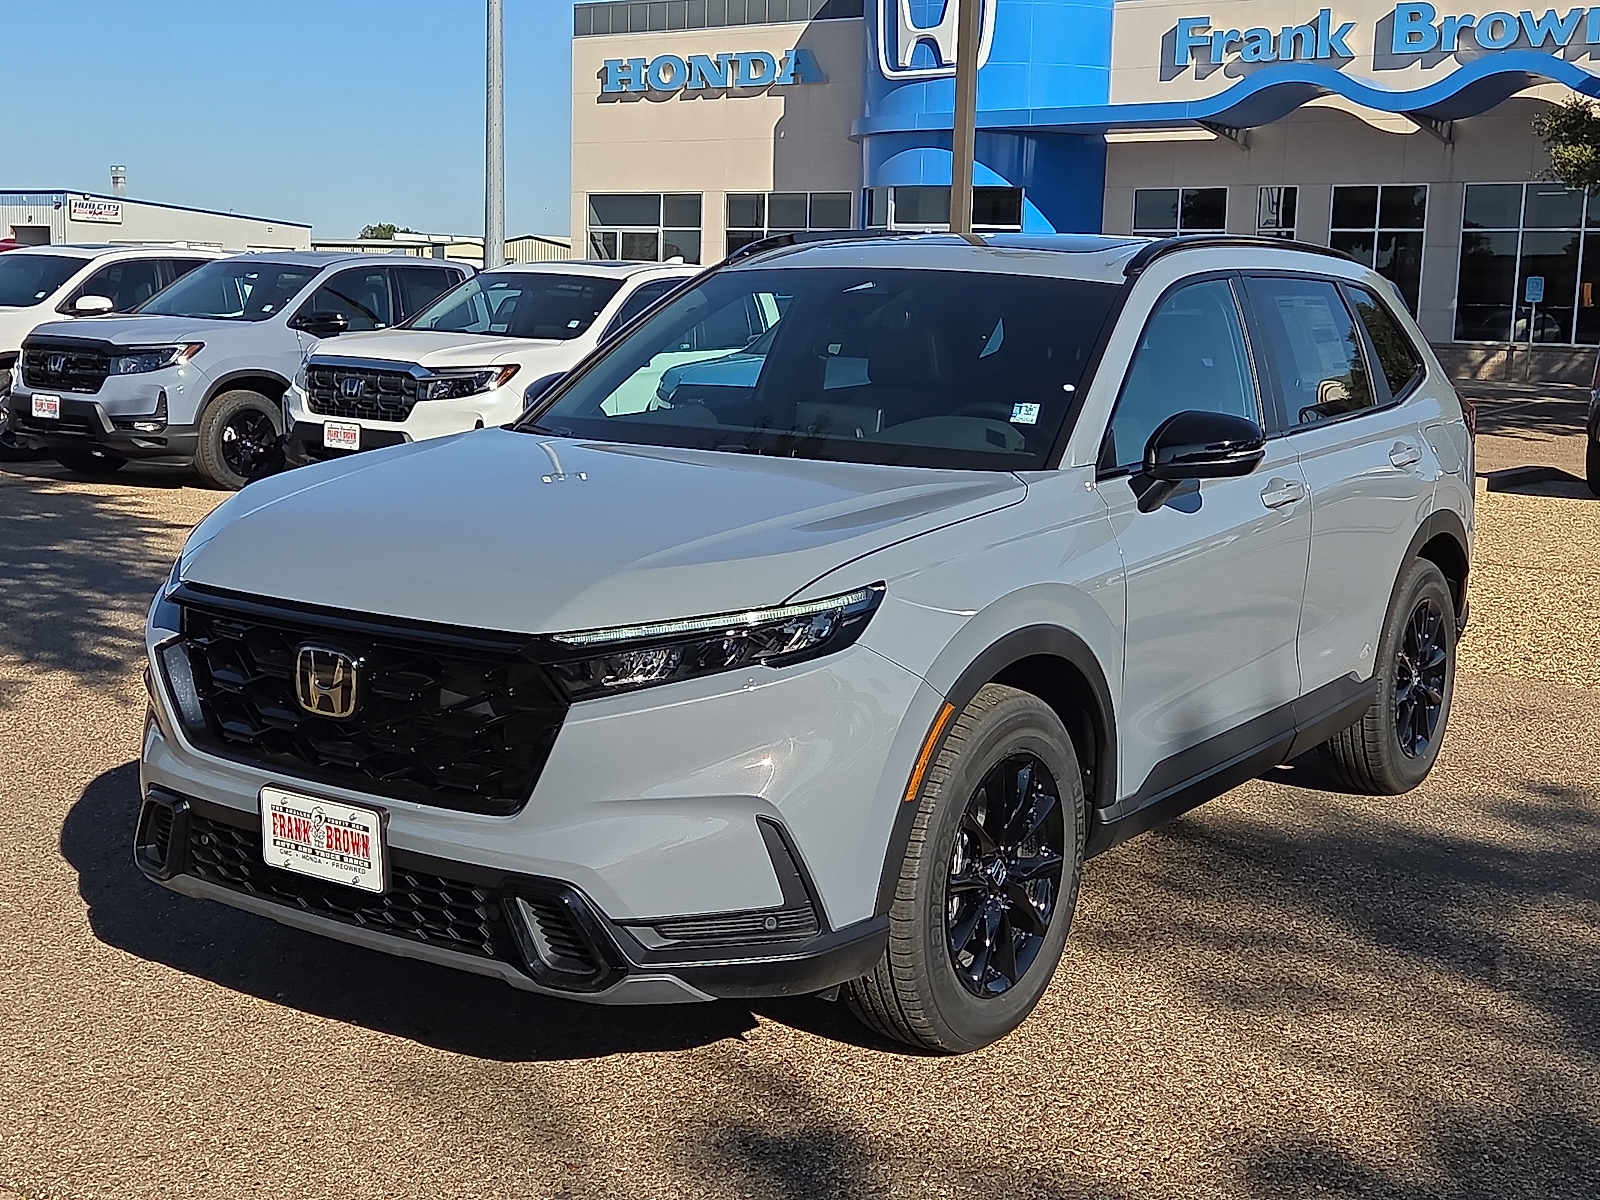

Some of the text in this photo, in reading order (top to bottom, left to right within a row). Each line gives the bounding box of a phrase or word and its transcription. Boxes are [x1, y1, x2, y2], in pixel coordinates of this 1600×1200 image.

[1174, 8, 1355, 67] Frank
[603, 49, 827, 93] HONDA
[271, 812, 370, 859] FRANK BROWN
[275, 840, 295, 850] AUTO
[297, 845, 312, 854] AND
[314, 849, 341, 861] TRUCK
[279, 848, 366, 874] GMC HONDA PREOWNED
